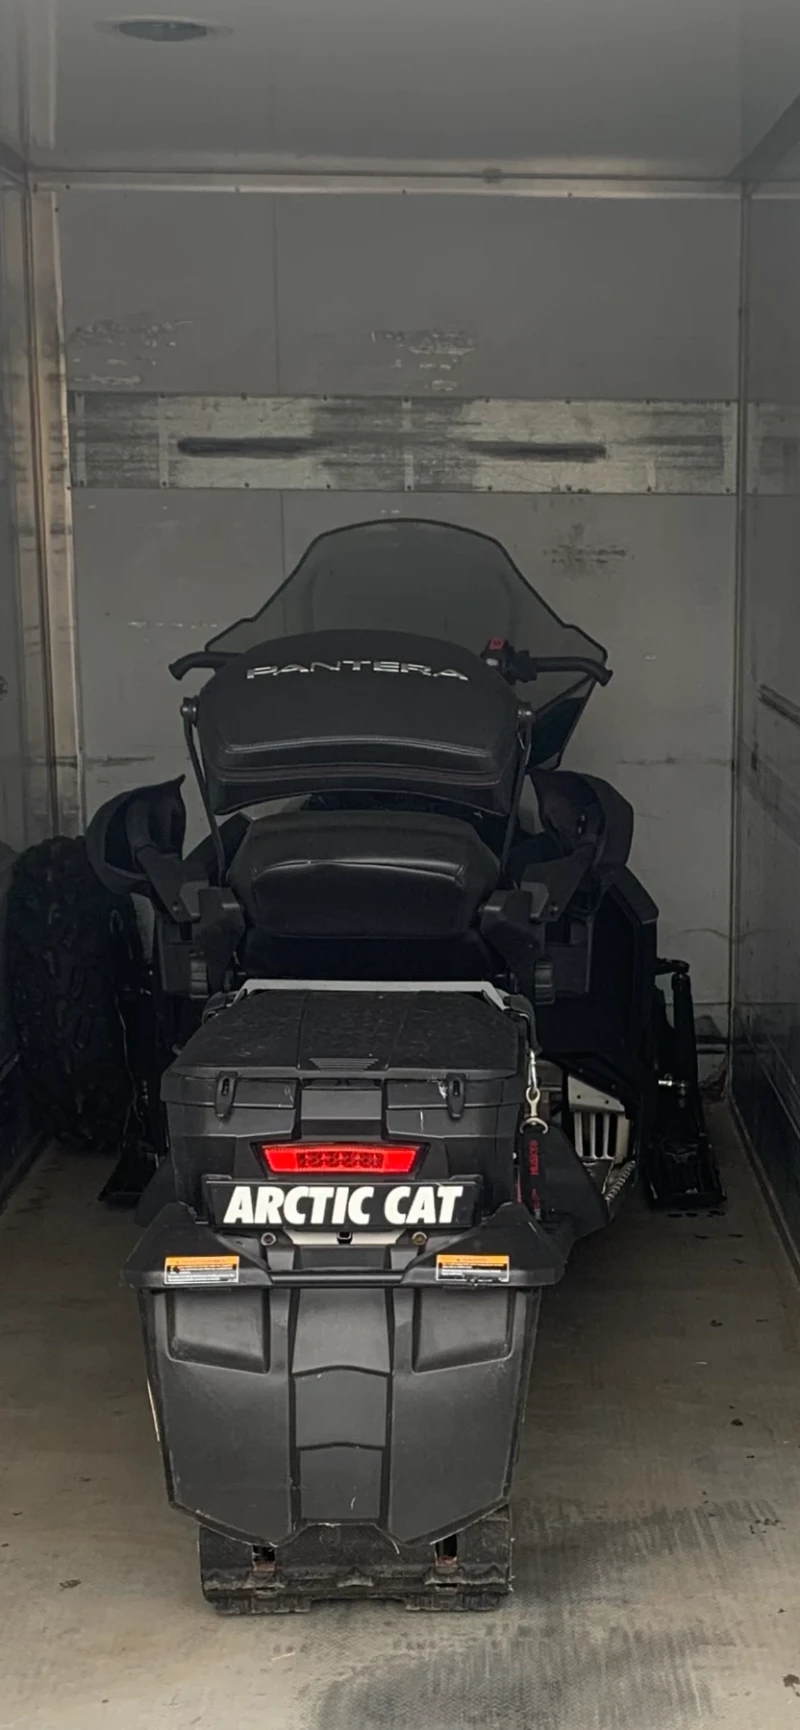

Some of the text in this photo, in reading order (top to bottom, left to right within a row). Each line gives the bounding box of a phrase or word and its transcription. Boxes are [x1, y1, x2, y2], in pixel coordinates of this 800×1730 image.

[247, 660, 468, 681] PANTERA
[223, 1186, 463, 1224] ARCTIC CAT
